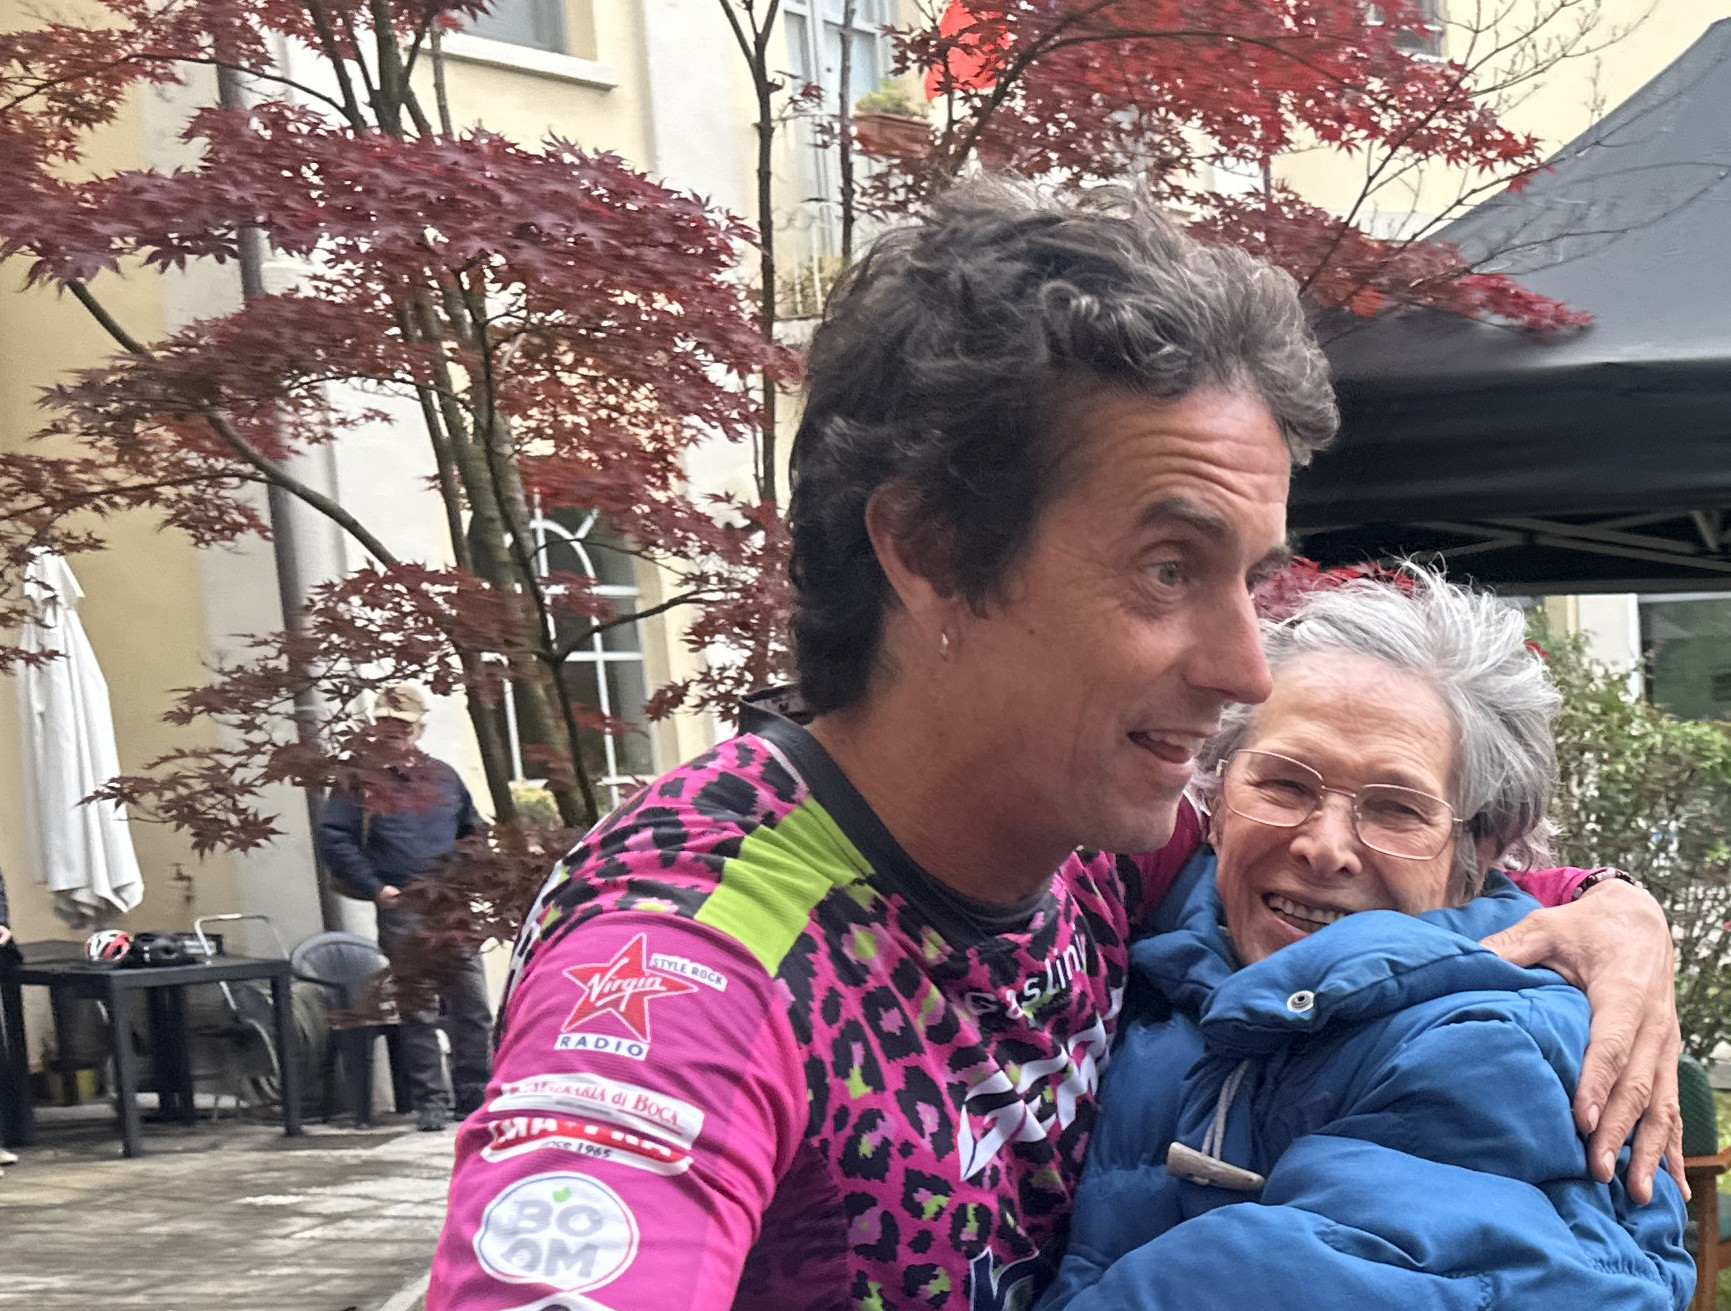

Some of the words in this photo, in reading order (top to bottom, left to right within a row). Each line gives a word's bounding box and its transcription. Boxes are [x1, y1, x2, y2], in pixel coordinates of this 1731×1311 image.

[587, 957, 667, 1012] Virgin
[653, 958, 687, 974] STYLE
[691, 966, 723, 986] ROCK
[560, 1036, 644, 1057] RADIO
[611, 1092, 627, 1107] di
[632, 1094, 680, 1126] BOCA
[577, 1142, 613, 1159] 1965
